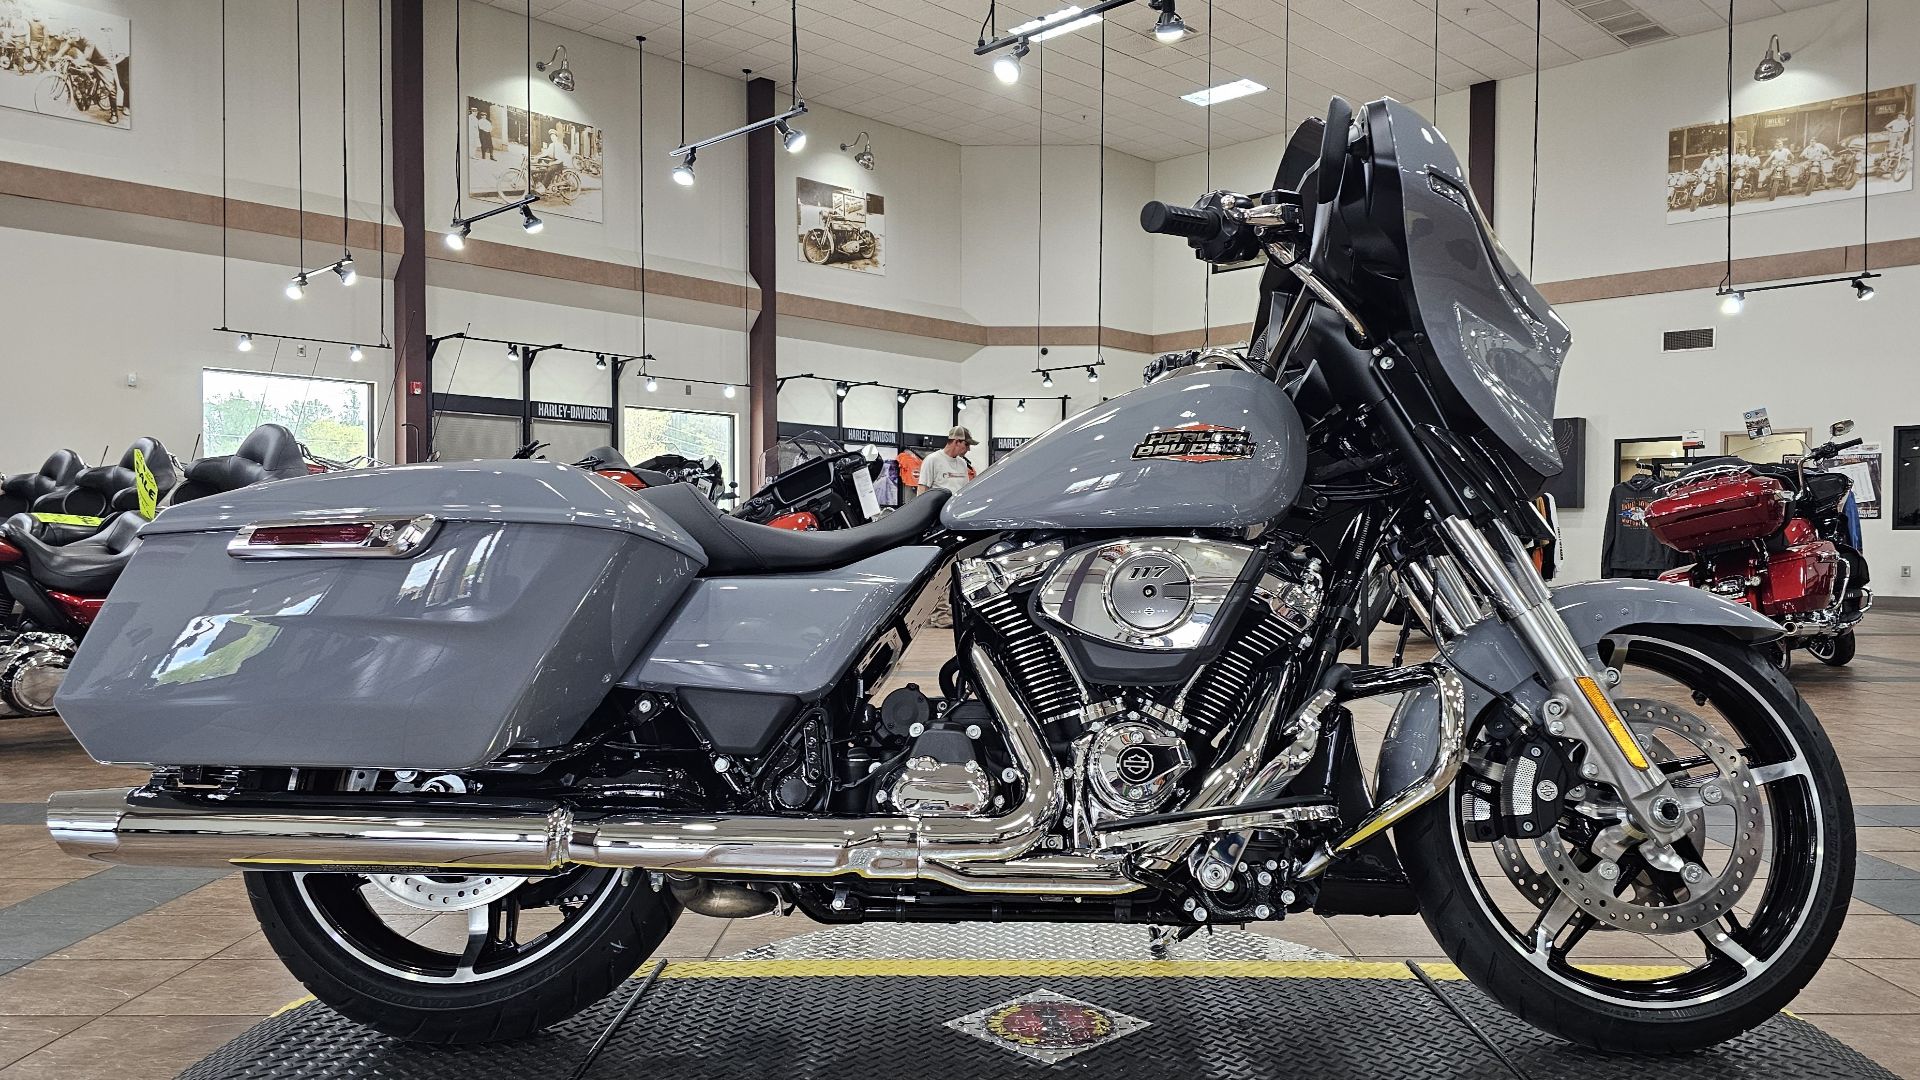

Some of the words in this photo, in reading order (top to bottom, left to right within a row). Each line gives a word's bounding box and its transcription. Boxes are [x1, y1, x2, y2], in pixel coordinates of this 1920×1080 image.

[538, 403, 608, 421] HARLEY-DAVIDSON
[848, 429, 896, 443] HARLEY-DAVIDSON
[1135, 443, 1257, 457] DAVIDSON
[1128, 564, 1172, 580] 117
